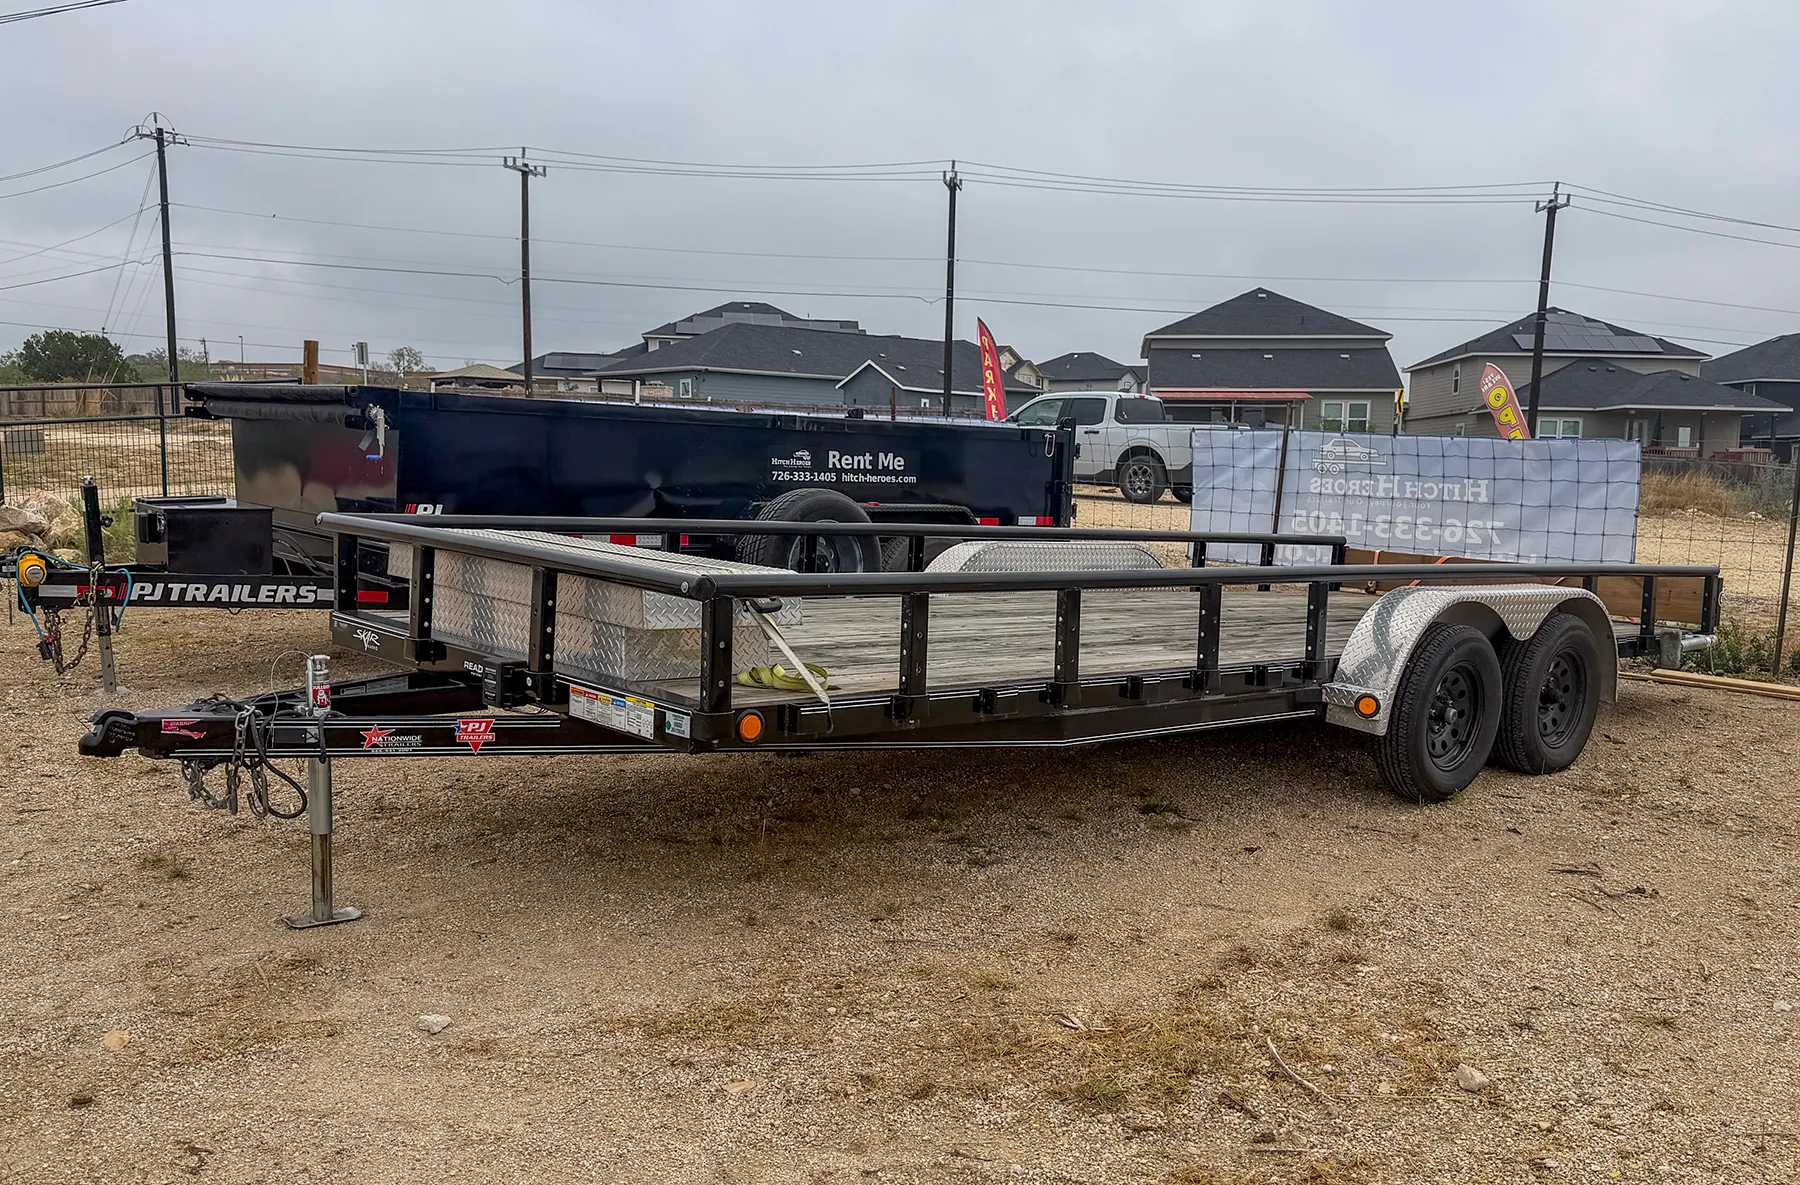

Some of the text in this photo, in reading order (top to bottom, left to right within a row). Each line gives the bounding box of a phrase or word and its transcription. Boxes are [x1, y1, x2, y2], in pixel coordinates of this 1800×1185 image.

[828, 450, 905, 470] Rent Me
[771, 471, 836, 482] 726-333-1405
[842, 472, 917, 483] hitch-heroes.com
[130, 583, 317, 603] PJ TRAILERS
[467, 722, 487, 732] PJ
[371, 734, 422, 742] NATIONWIDE
